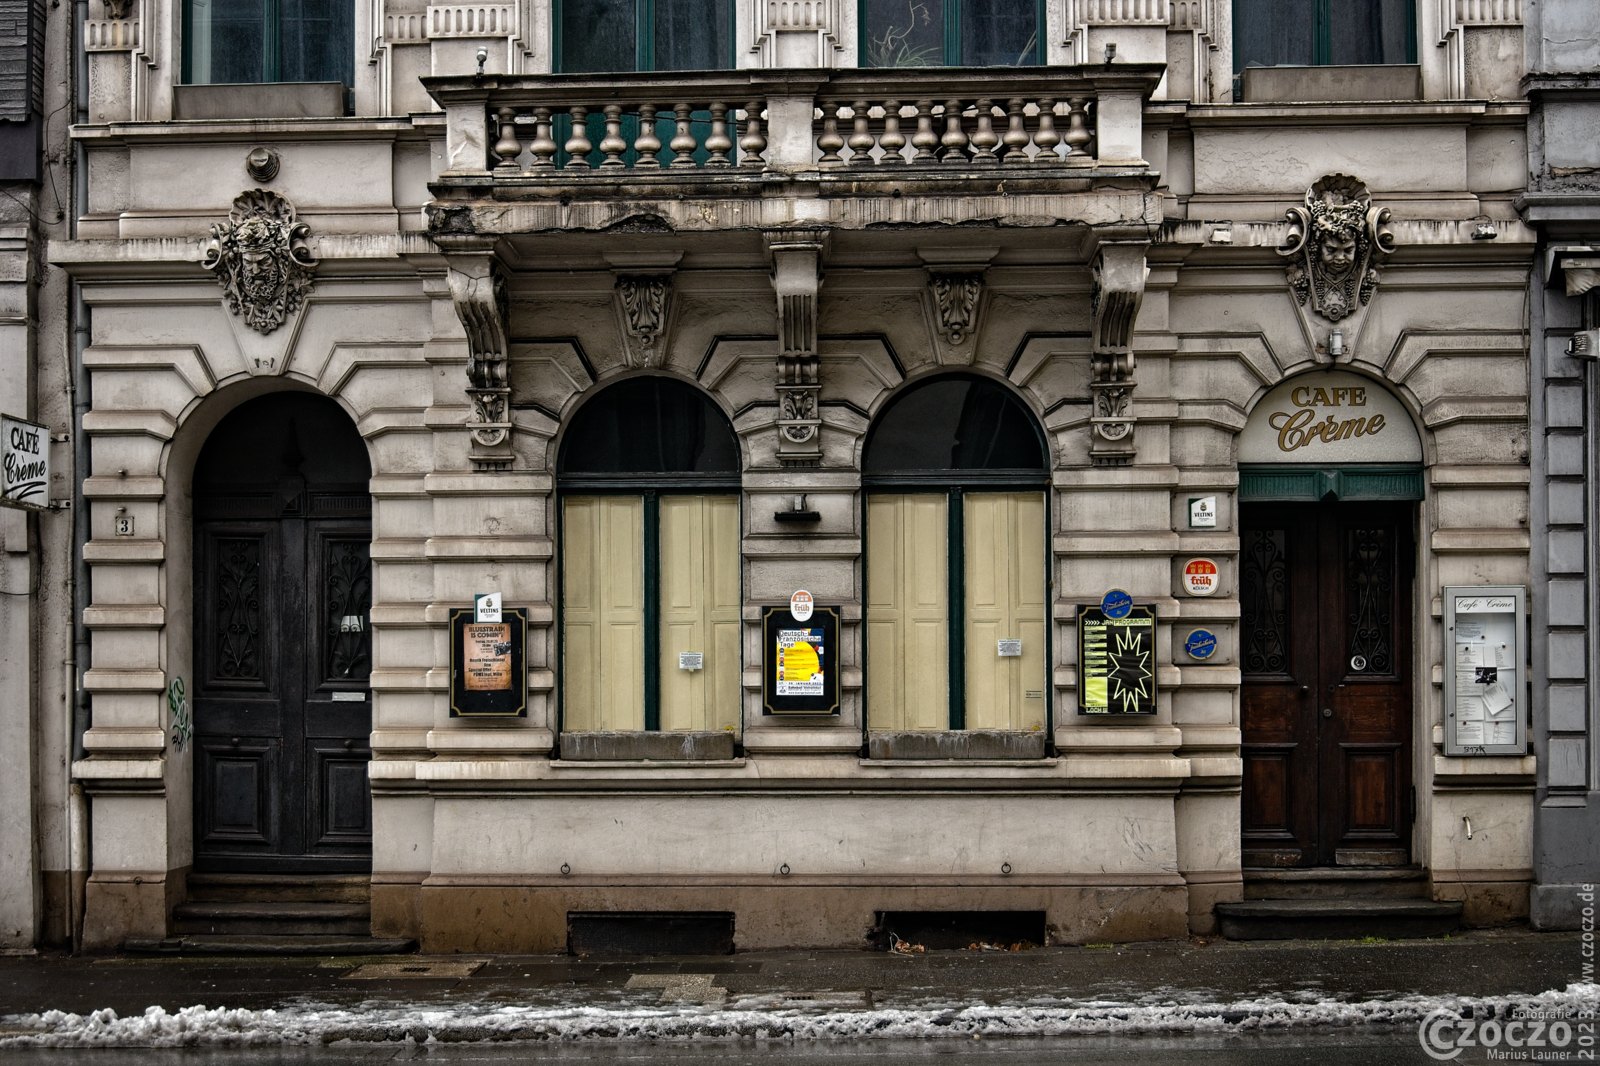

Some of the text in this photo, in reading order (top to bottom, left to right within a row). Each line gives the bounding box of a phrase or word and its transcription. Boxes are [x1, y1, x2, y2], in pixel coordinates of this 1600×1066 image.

[1291, 386, 1367, 407] CAFE
[10, 427, 39, 455] CAFÉ
[1268, 409, 1386, 452] Crème
[4, 452, 46, 484] Crème
[121, 520, 128, 532] 3
